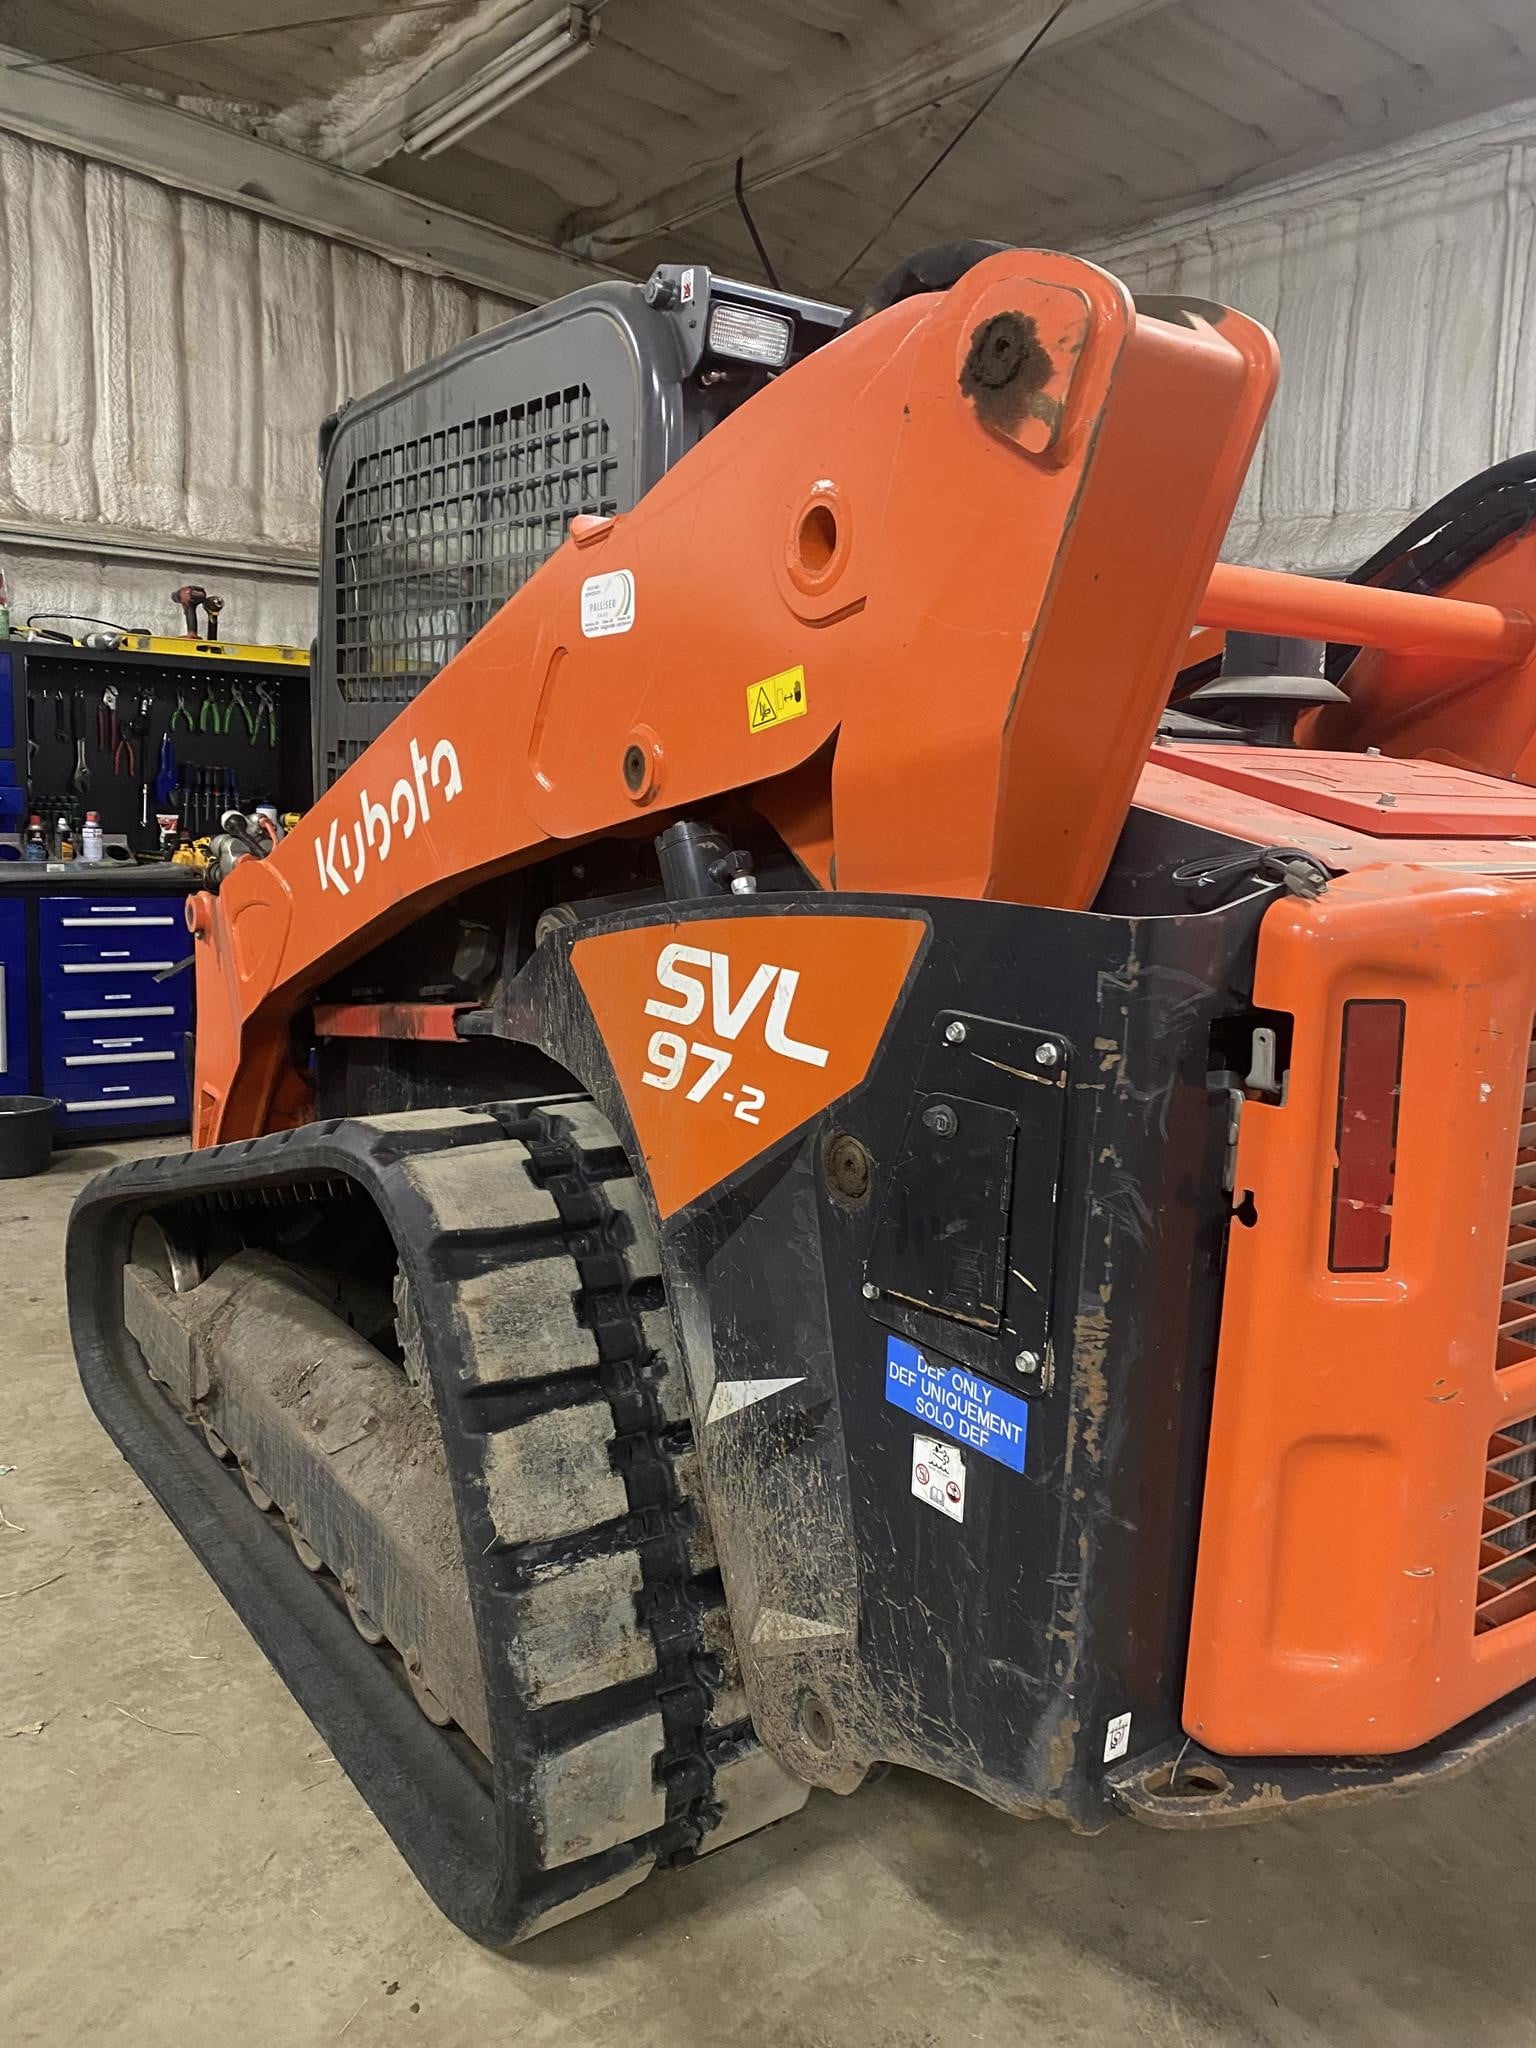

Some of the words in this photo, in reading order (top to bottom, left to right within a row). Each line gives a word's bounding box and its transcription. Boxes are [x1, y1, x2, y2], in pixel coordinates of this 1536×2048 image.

[589, 599, 616, 612] PALLISER
[314, 737, 463, 896] Kubota
[643, 942, 829, 1068] SVL
[641, 1030, 766, 1126] 97-2
[889, 1361, 917, 1388] DEF
[920, 1379, 1023, 1444] UNIQUEMENT
[915, 1397, 954, 1430] SOLO
[958, 1421, 990, 1448] DEF
[951, 1374, 992, 1407] ONLY
